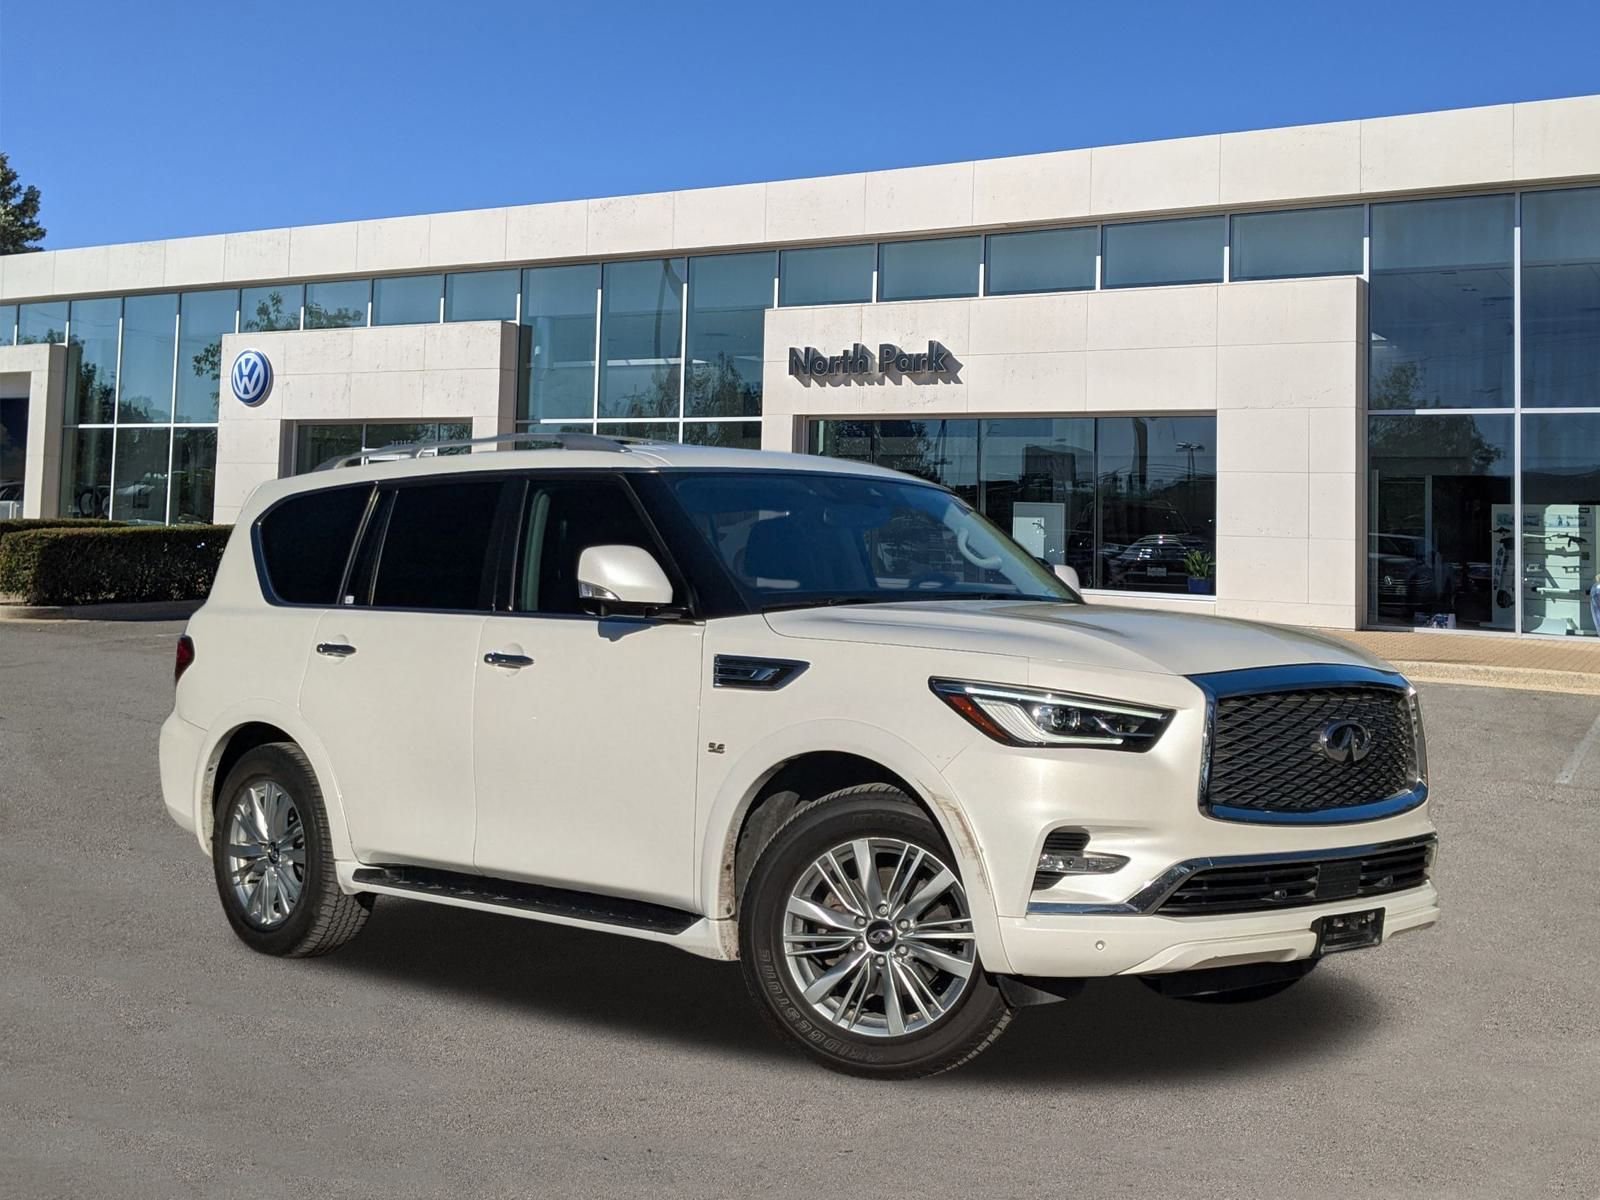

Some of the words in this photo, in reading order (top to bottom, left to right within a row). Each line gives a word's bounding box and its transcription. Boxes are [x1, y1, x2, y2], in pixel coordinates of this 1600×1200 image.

[232, 352, 265, 401] VW
[789, 343, 872, 376] North
[878, 340, 948, 373] Park
